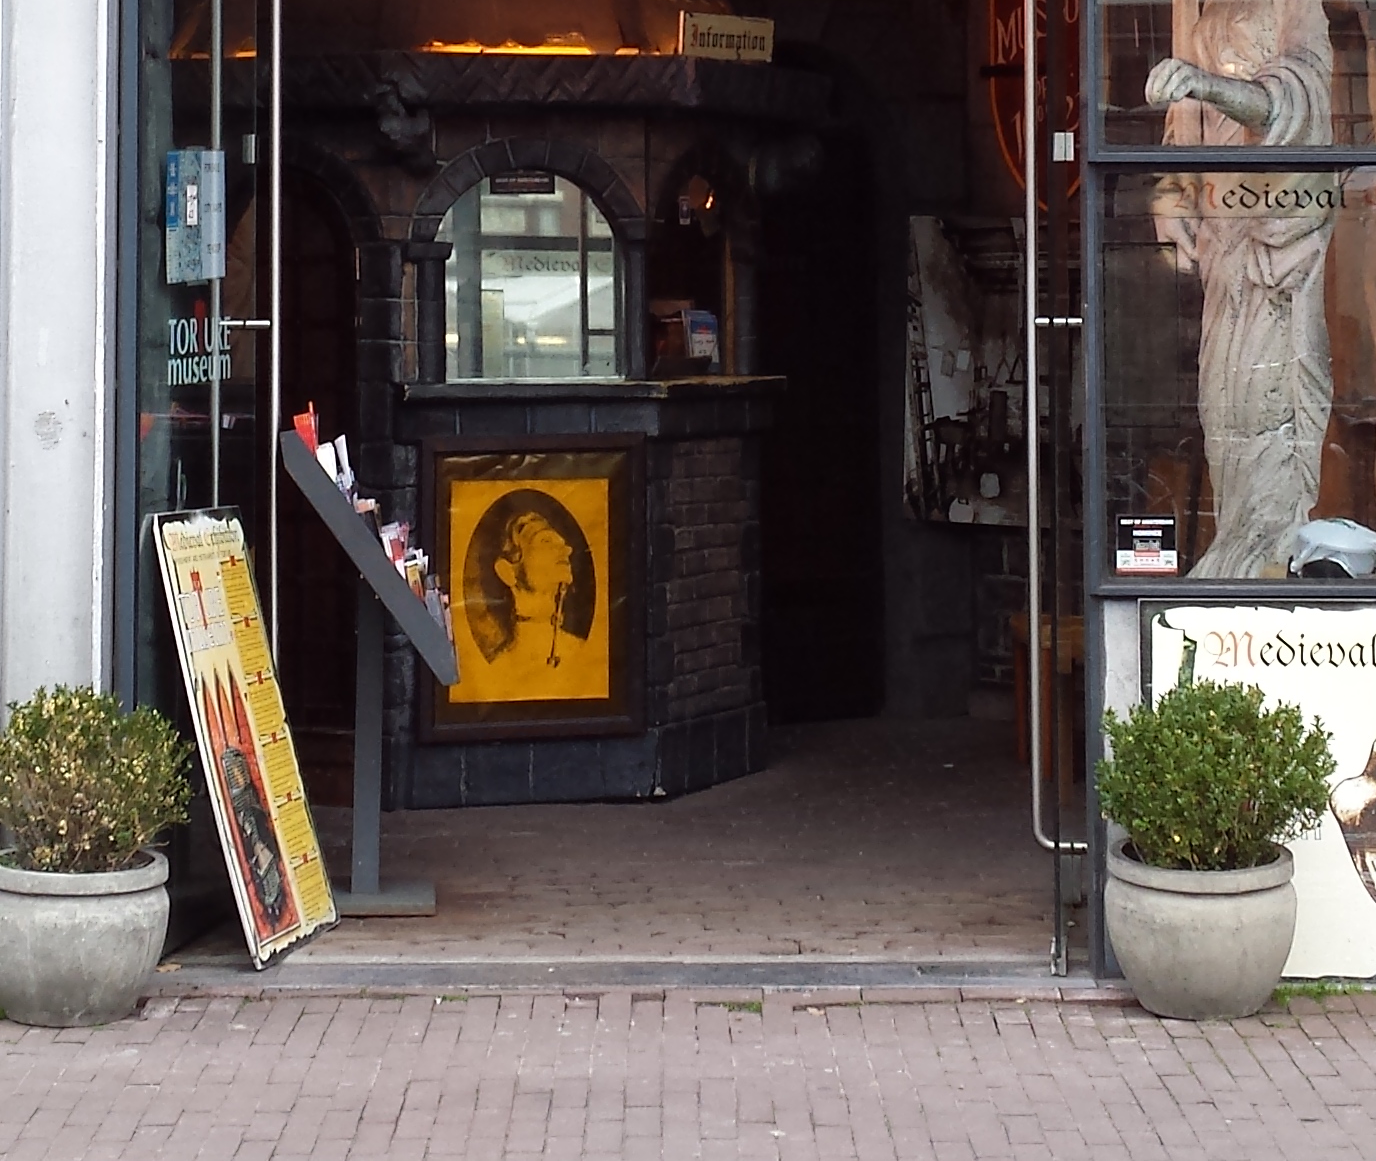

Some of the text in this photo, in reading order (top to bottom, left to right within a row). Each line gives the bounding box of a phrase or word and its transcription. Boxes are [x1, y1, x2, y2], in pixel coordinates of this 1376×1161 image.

[689, 22, 767, 53] Information
[1173, 176, 1348, 210] Medieval
[500, 254, 581, 273] Medieva
[168, 353, 231, 387] museum
